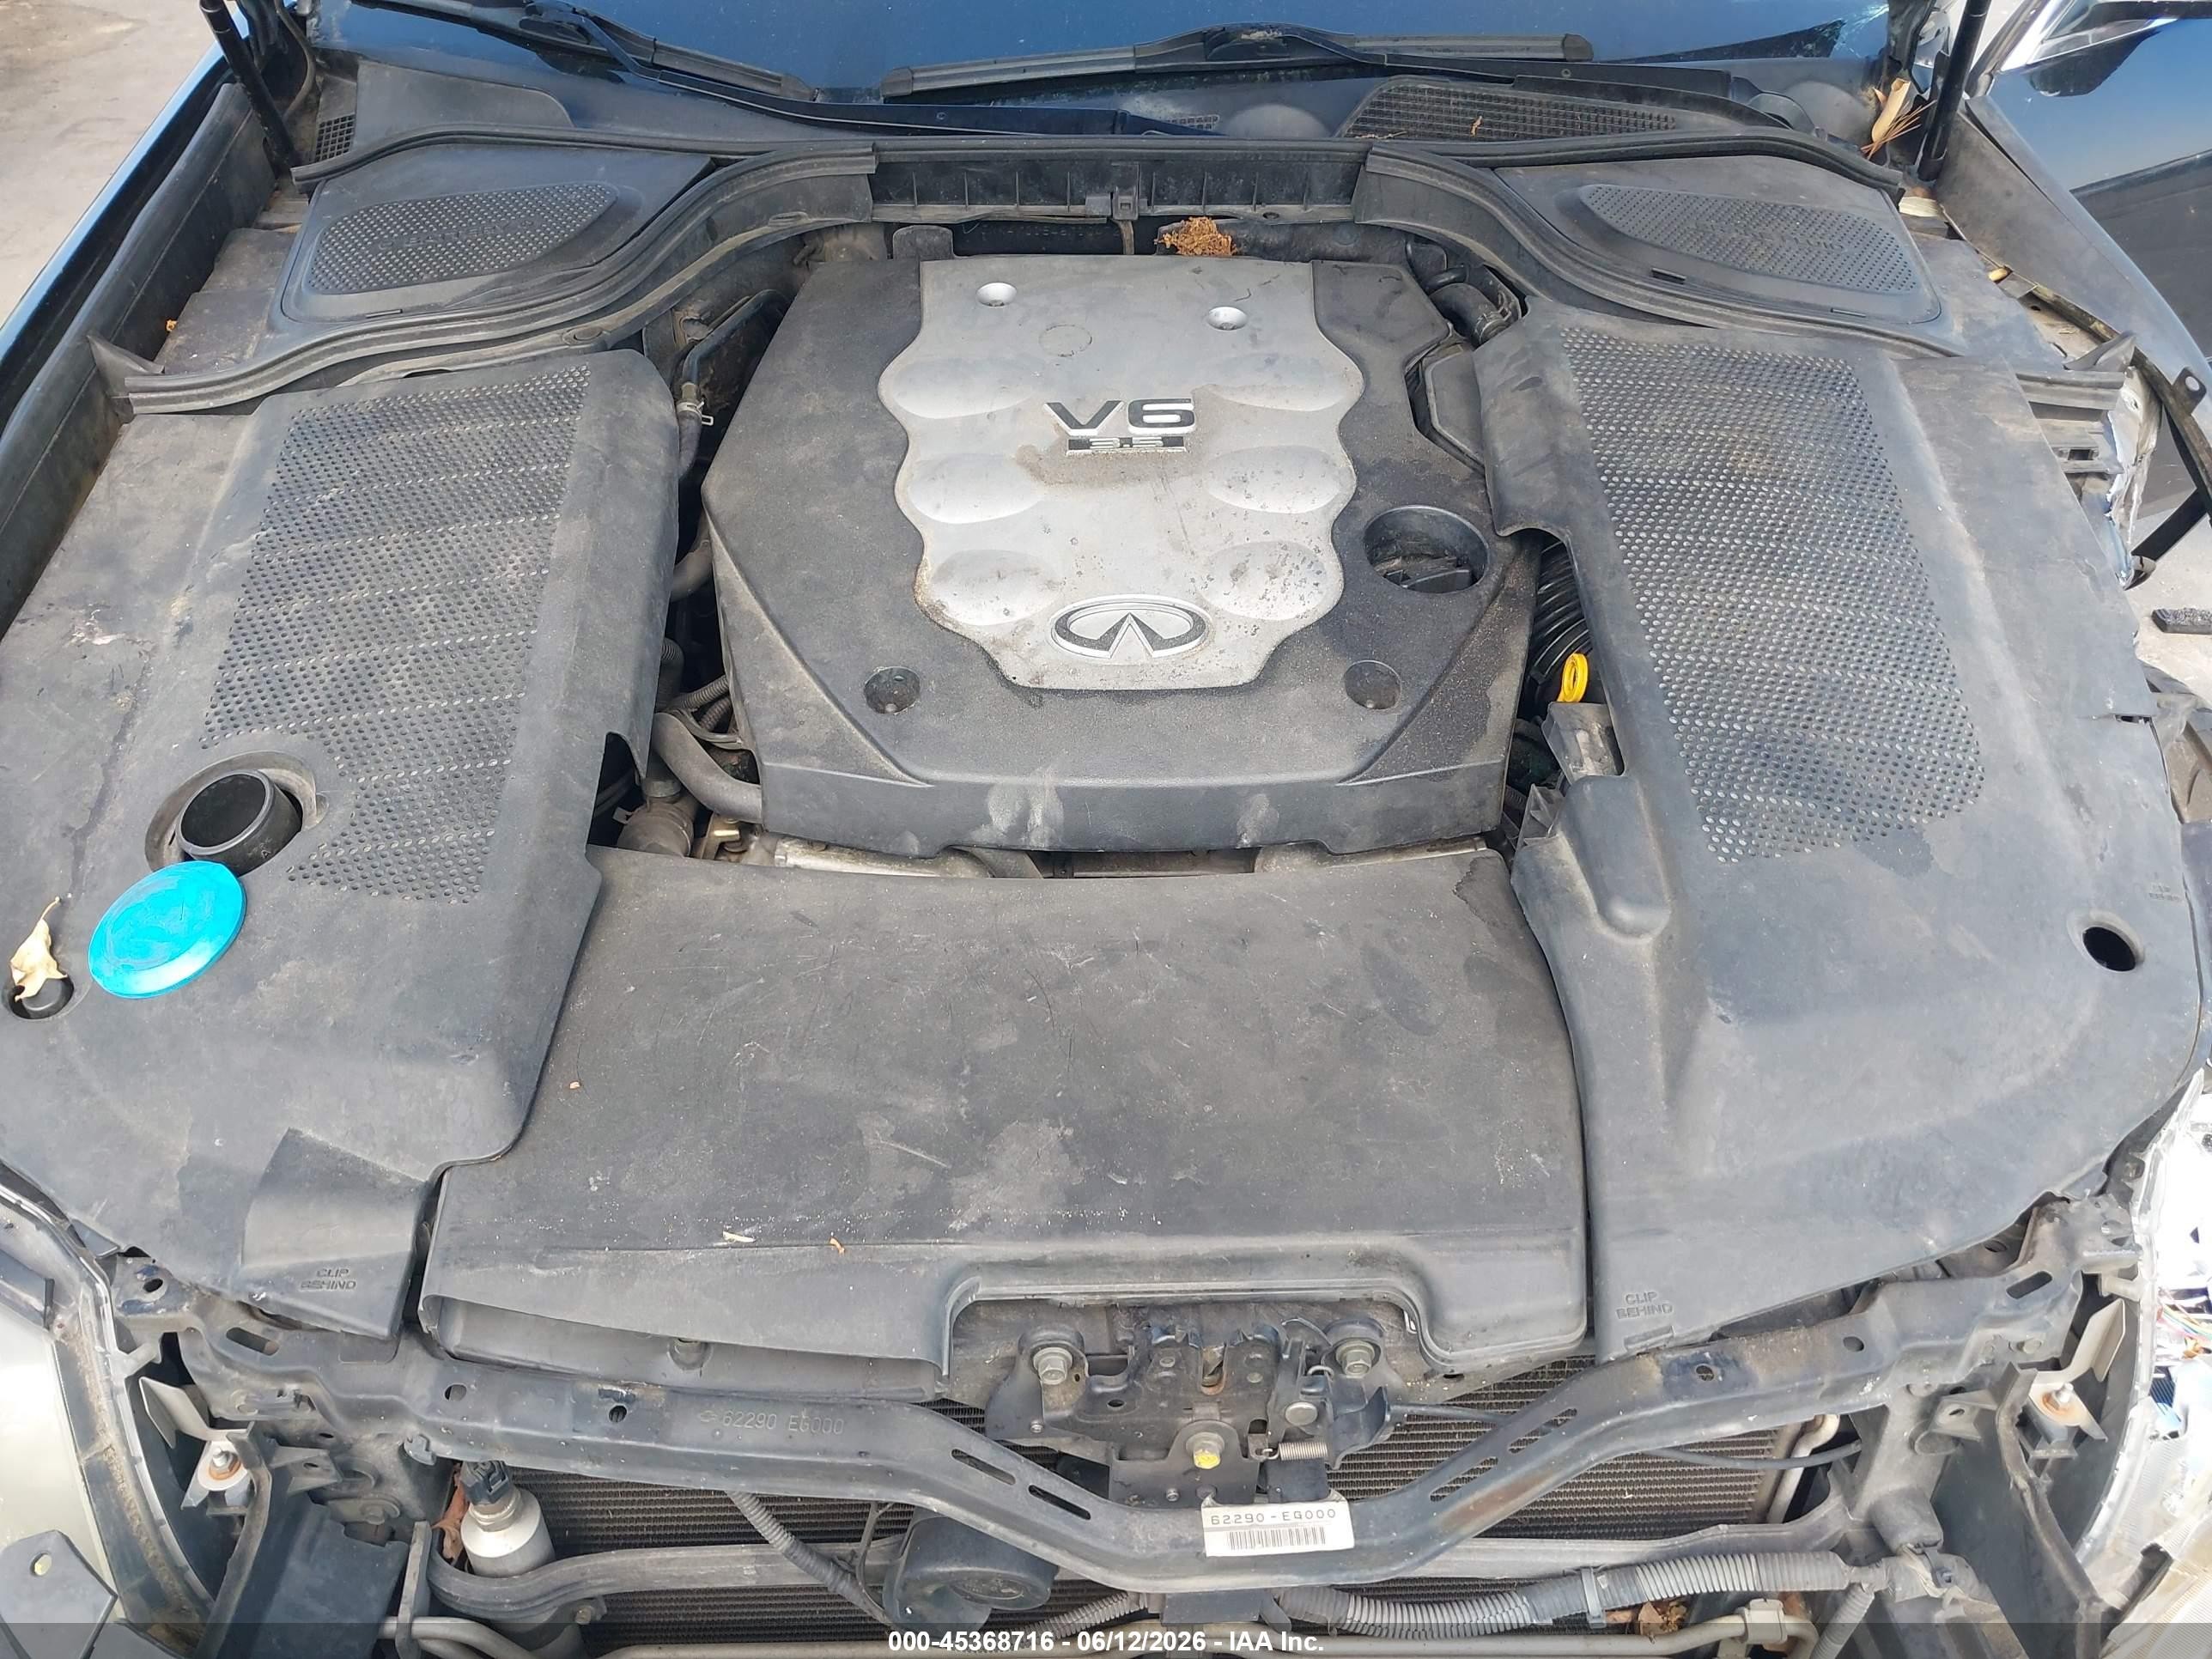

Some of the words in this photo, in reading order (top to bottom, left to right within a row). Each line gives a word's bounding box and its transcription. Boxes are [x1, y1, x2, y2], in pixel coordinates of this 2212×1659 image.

[1043, 398, 1196, 436] V6
[1089, 436, 1164, 448] 3.5
[317, 1268, 350, 1278] CLIP
[1626, 1291, 1657, 1304] CLIP
[1616, 1304, 1674, 1320] BEHIND
[722, 1410, 777, 1430] 62290
[788, 1414, 844, 1435] EG000
